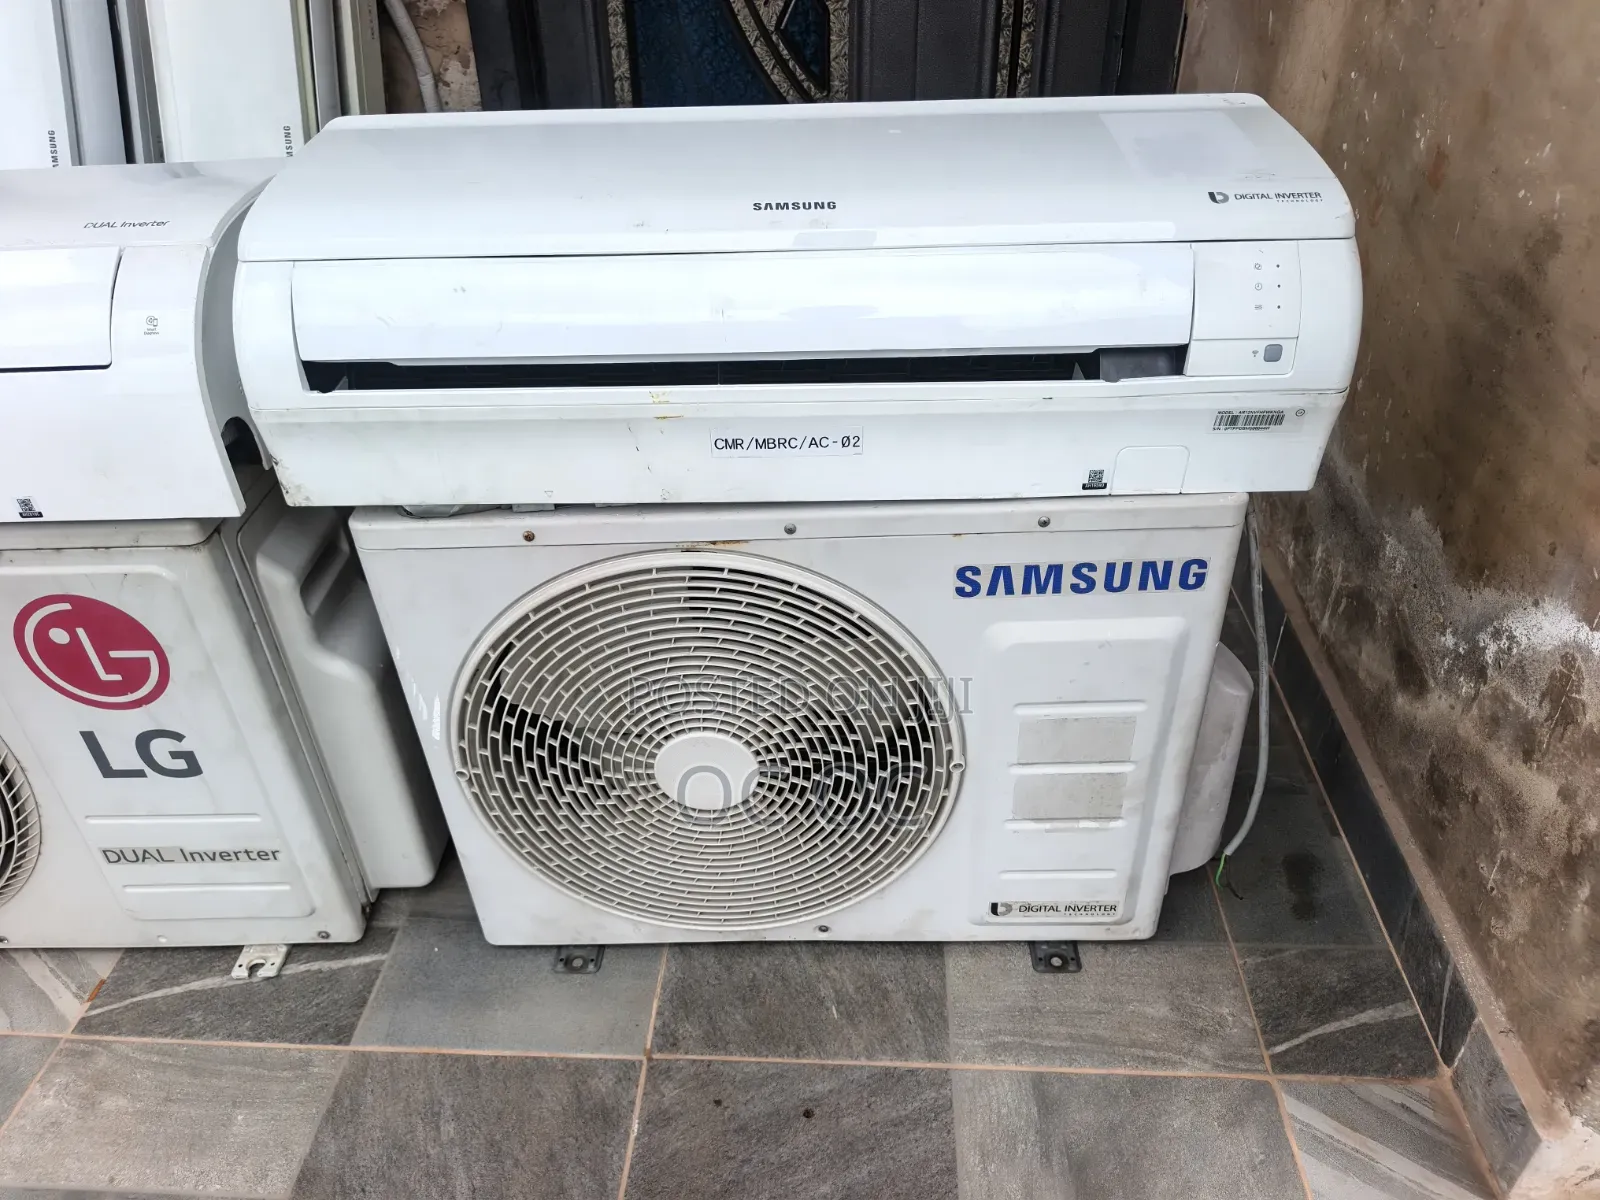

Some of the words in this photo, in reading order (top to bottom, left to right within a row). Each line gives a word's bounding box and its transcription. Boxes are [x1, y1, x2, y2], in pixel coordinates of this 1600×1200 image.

[48, 130, 59, 168] AMSUNG
[283, 125, 293, 157] MSUNG
[1275, 191, 1322, 199] INVERTER
[753, 201, 837, 211] SAMSUNG
[83, 221, 118, 229] DUAL
[120, 220, 170, 228] Inverter
[955, 558, 1208, 598] SAMSUNG
[79, 729, 204, 779] LG
[102, 849, 175, 864] DUAL
[179, 848, 280, 862] Inverter
[1018, 905, 1061, 913] DIGITAL
[1064, 904, 1117, 912] INVERTER
